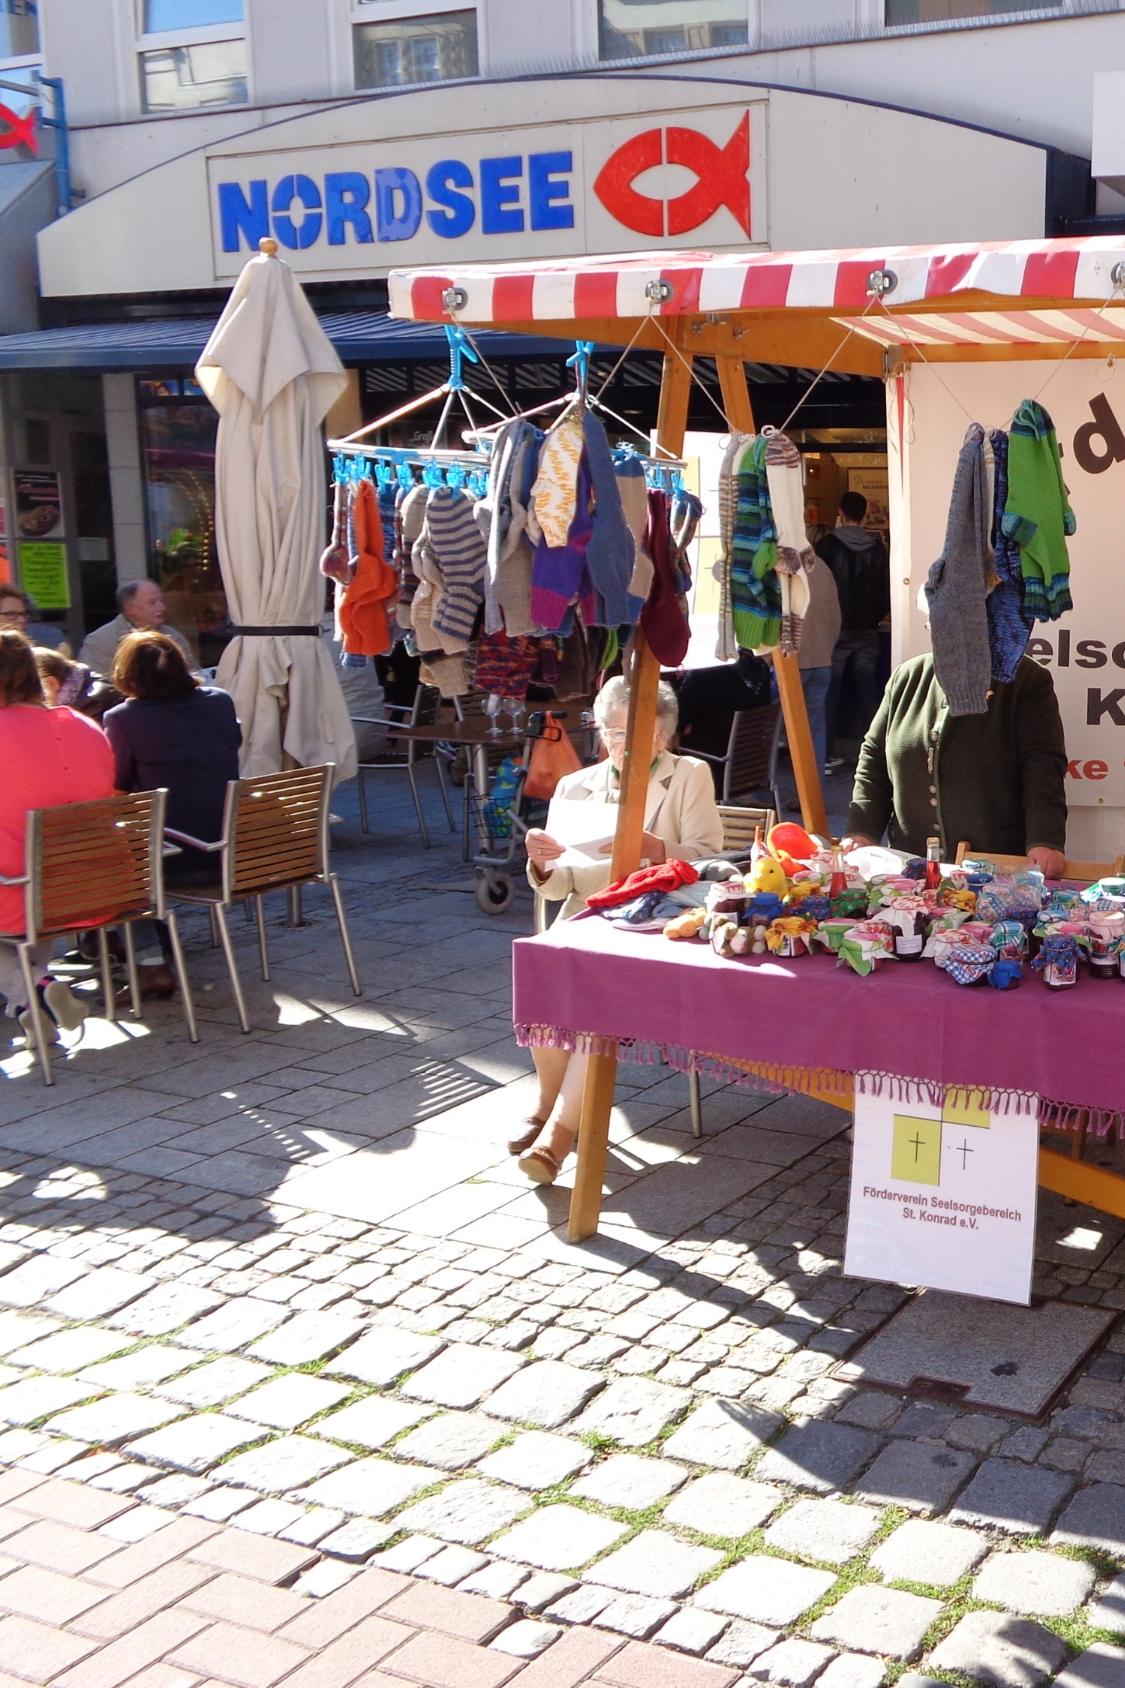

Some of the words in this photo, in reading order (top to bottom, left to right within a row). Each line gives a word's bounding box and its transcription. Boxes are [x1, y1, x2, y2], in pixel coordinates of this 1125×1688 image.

[218, 150, 574, 253] NORDSEE
[863, 1186, 928, 1206] Förderverein
[930, 1196, 1022, 1222] Seelsorgebereich
[902, 1207, 917, 1221] St.
[919, 1209, 957, 1227] Konrad
[959, 1217, 979, 1231] e.V.
